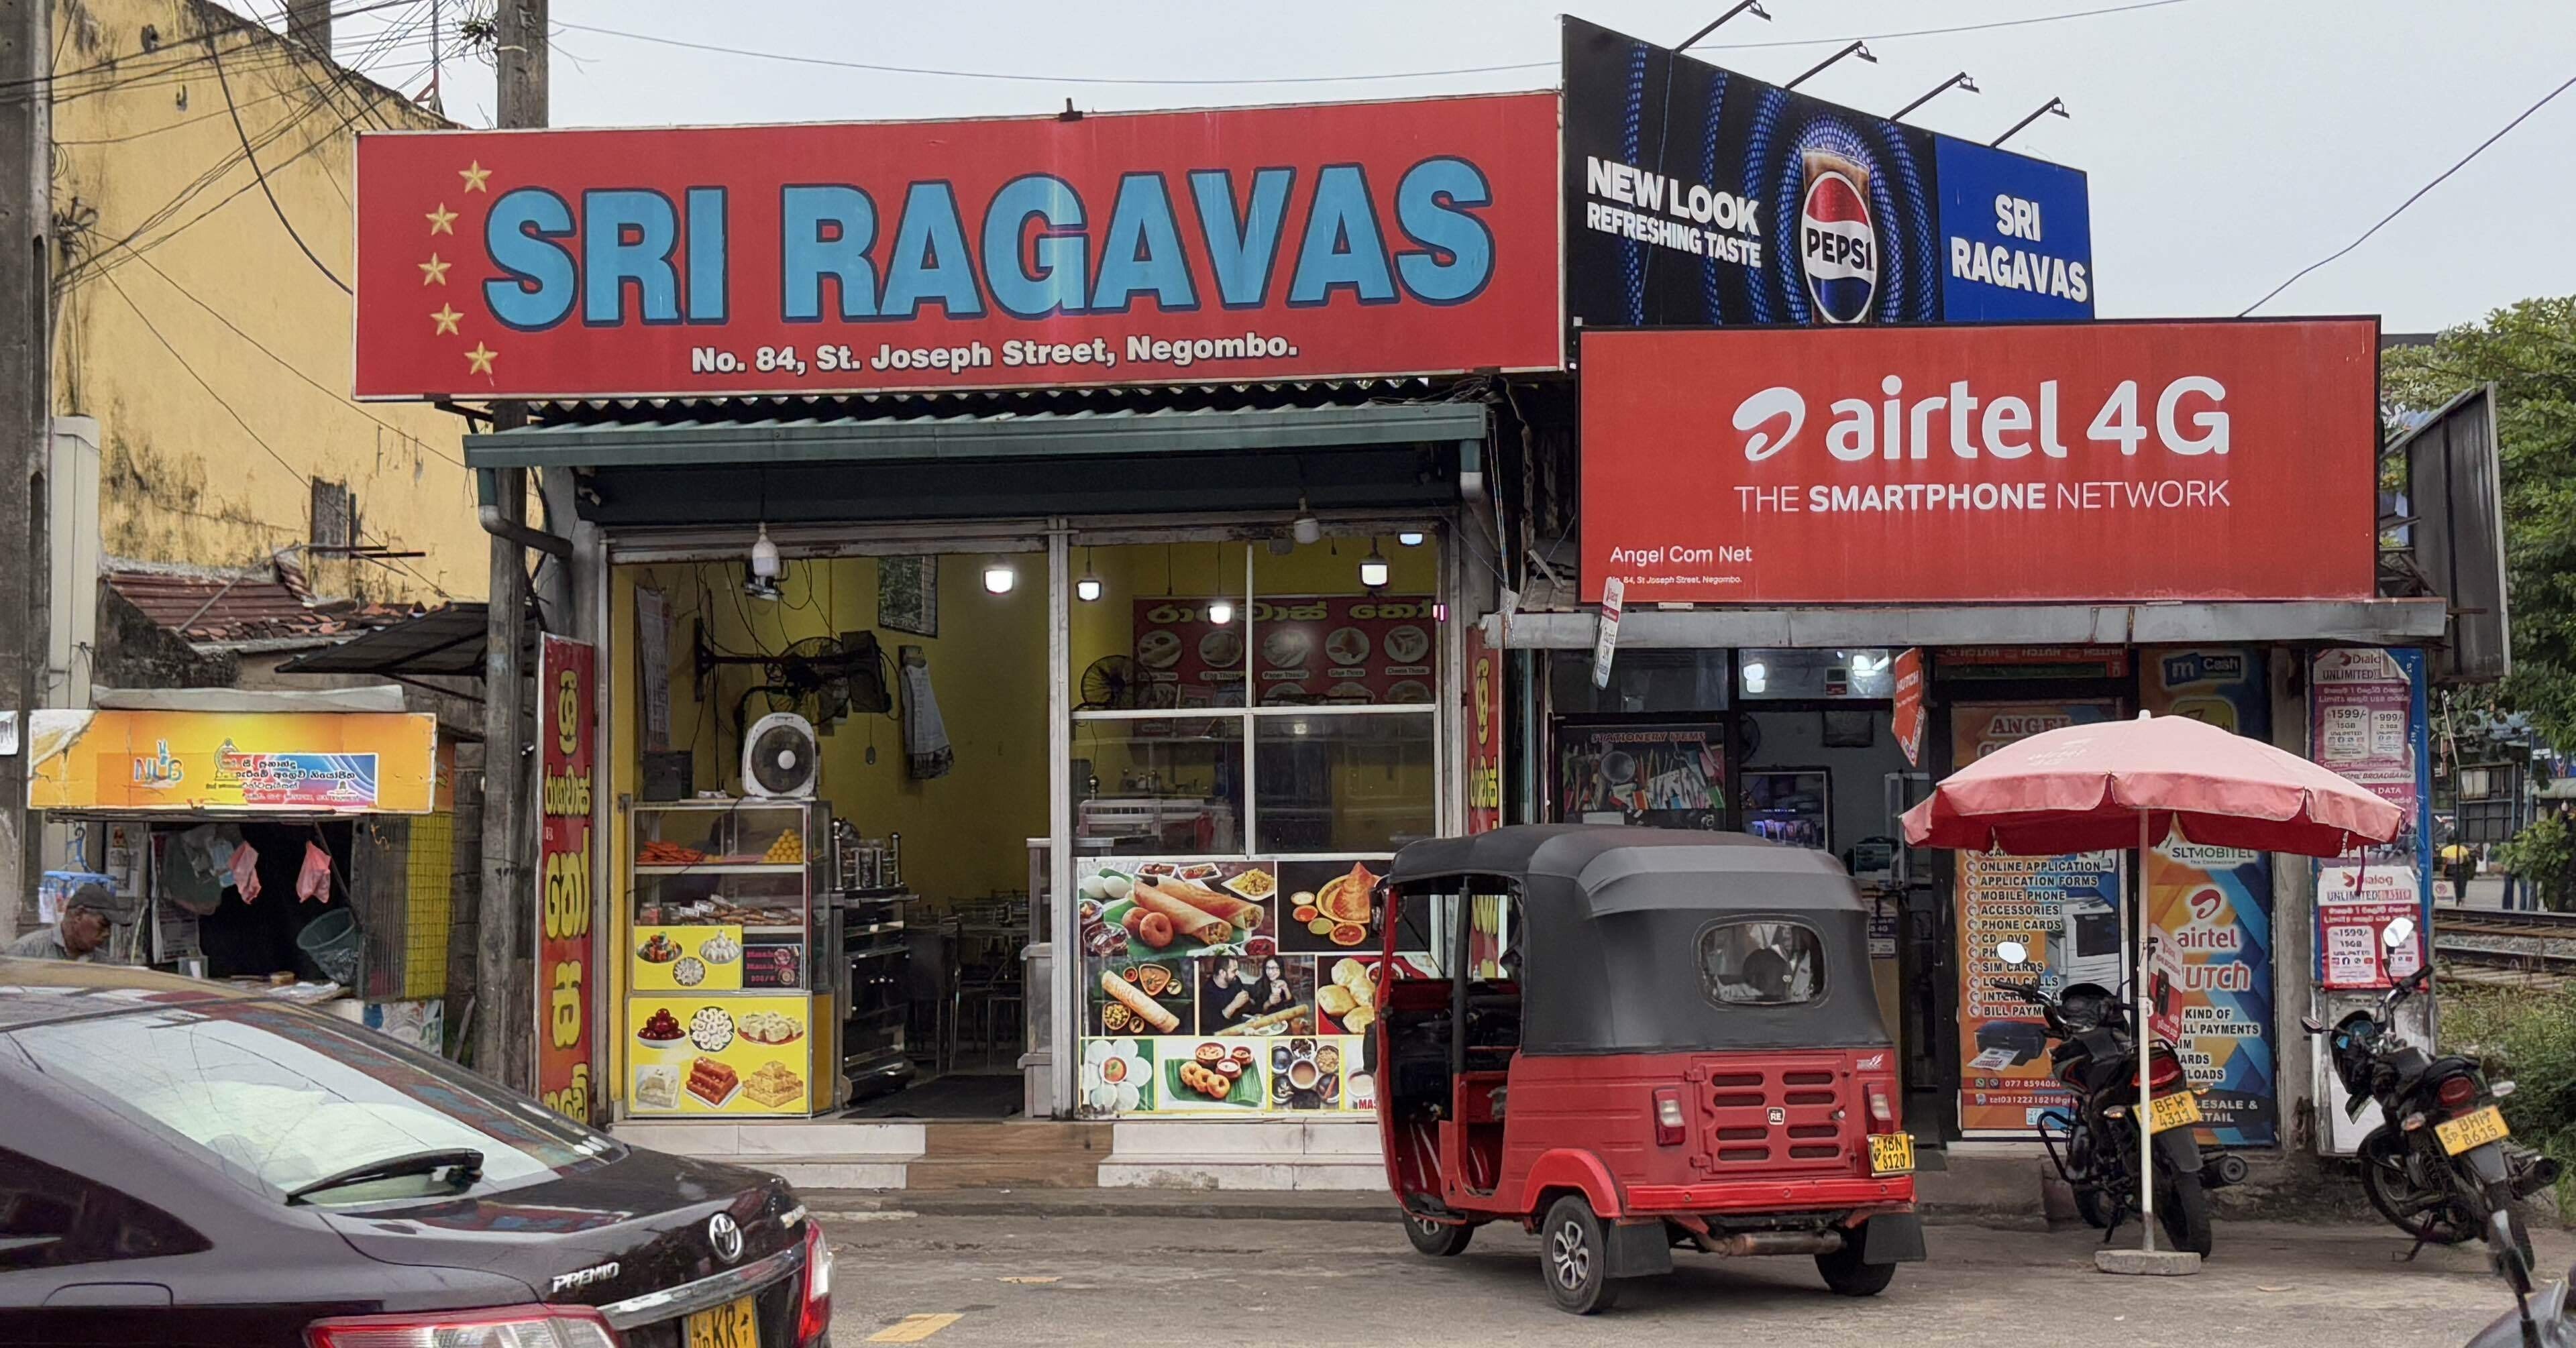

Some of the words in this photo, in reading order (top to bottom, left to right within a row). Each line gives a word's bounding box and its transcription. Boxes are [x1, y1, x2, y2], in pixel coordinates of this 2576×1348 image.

[1586, 156, 1663, 212] NEW
[1670, 177, 1761, 237] LOOK
[1994, 194, 2041, 243] SRI
[1587, 201, 1702, 254] REFRESHING
[1703, 229, 1762, 268] TASTE
[482, 186, 729, 332] SRI
[780, 154, 1496, 323] RAGAVAS
[1807, 228, 1874, 272] PEPSI
[1950, 236, 2088, 303] RAGAVAS
[692, 347, 746, 374] No.
[755, 345, 806, 375] 84,
[816, 344, 861, 371] St.
[870, 339, 991, 374] Joseph
[1002, 337, 1116, 368] Street,
[1126, 333, 1299, 366] Negombo.
[1825, 374, 2067, 460] airtel
[2086, 376, 2230, 455] 4G
[1733, 486, 1799, 512] THE
[1809, 483, 2046, 512] SMARTPHONE
[2057, 480, 2230, 509] NETWORK
[1610, 547, 1664, 567] Angel
[1670, 546, 1712, 562] Com
[1719, 546, 1752, 562] Net
[1646, 576, 1674, 585] Joseph
[2203, 658, 2239, 670] Cash
[2323, 671, 2373, 679] UNLIMITED
[1896, 671, 1919, 695] HUTCH
[1591, 732, 1668, 743] STATIONERY
[1980, 862, 2022, 871] ONLINE
[2026, 862, 2101, 871] APPLICATION
[1980, 877, 2055, 886] APPLICATION
[2059, 877, 2098, 886] FORMS
[1981, 891, 2023, 901] MOBILE
[2027, 891, 2065, 900] PHONE
[1981, 905, 2059, 915] ACCESSORIES
[1982, 920, 2019, 930] PHONE
[2024, 920, 2061, 930] CARDS
[1982, 934, 1997, 943] CD
[2006, 934, 2030, 942] DVD
[2178, 927, 2238, 948] airtel
[1982, 962, 2002, 972] SIM
[1984, 1007, 2008, 1016] BILL
[2012, 1007, 2045, 1016] PAYM
[2185, 1009, 2212, 1019] KIND
[2216, 1009, 2231, 1019] OF
[2200, 1024, 2259, 1035] PAYMENTS
[2181, 1055, 2210, 1064] ARDS
[2197, 1101, 2244, 1110] LESALE
[2249, 1101, 2258, 1110] &
[1770, 1113, 1782, 1121] RE
[2159, 1107, 2192, 1127] 4311
[1882, 1135, 1903, 1153] ABN
[1882, 1152, 1906, 1170] 8120
[553, 1261, 621, 1293] PREMIO
